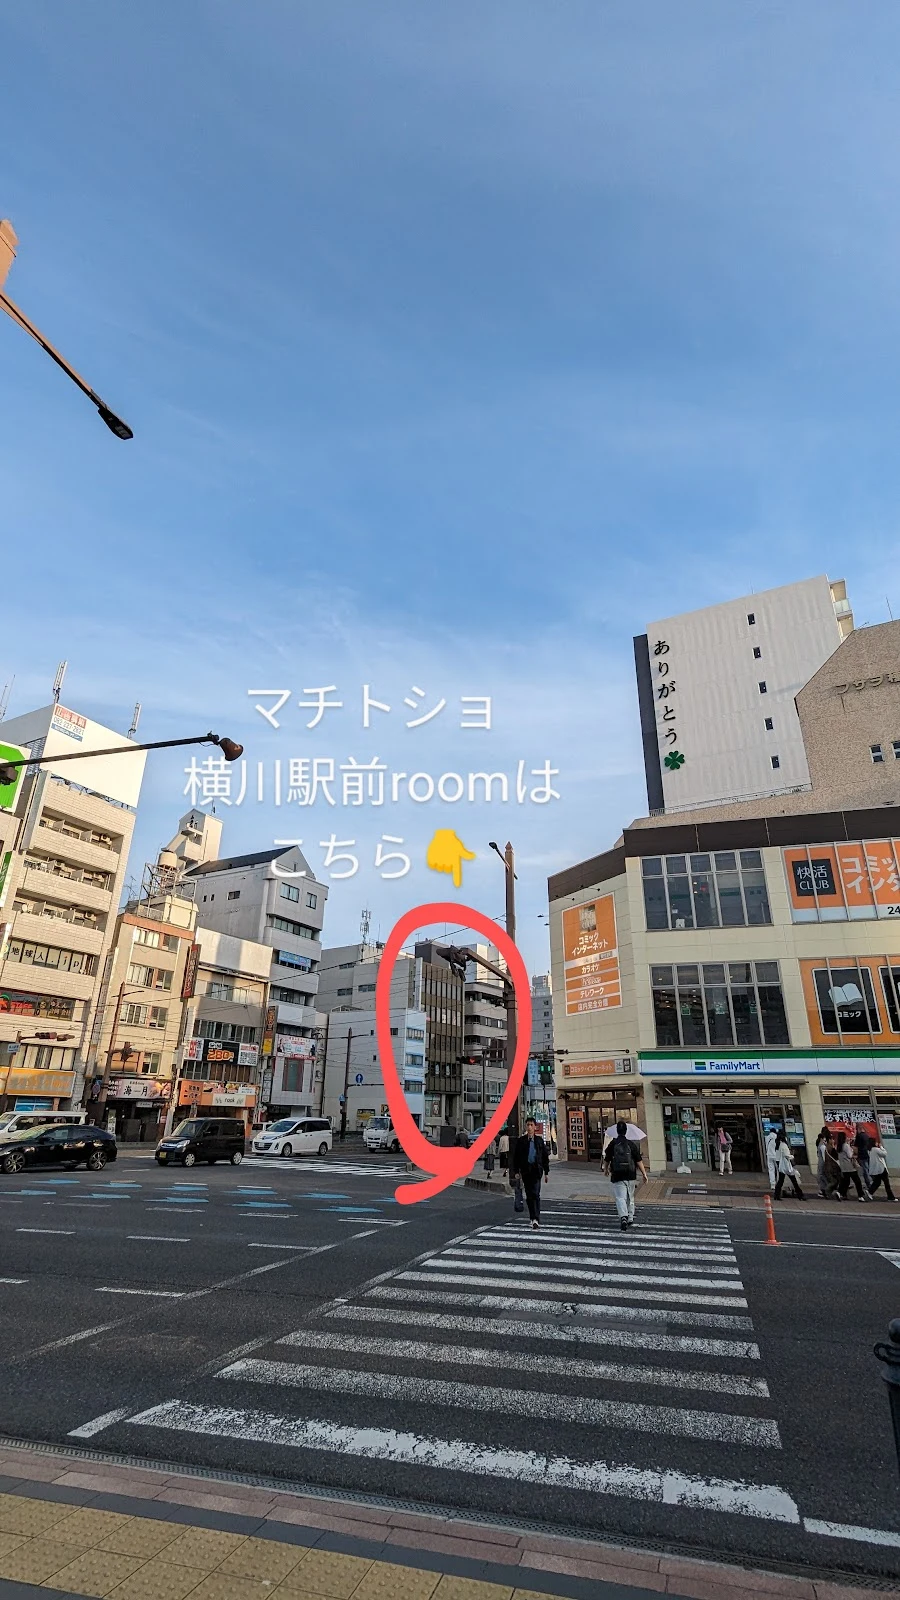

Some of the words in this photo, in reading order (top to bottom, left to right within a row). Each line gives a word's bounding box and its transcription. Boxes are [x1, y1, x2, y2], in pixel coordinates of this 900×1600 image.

[653, 640, 678, 745] ありがとう
[797, 865, 828, 879] 快活
[799, 880, 830, 891] CLUB
[578, 932, 599, 945] コミック
[571, 938, 609, 957] インターネット
[581, 963, 600, 974] カラオケ
[580, 987, 604, 998] テレワーク
[709, 1061, 761, 1072] FamilyMart
